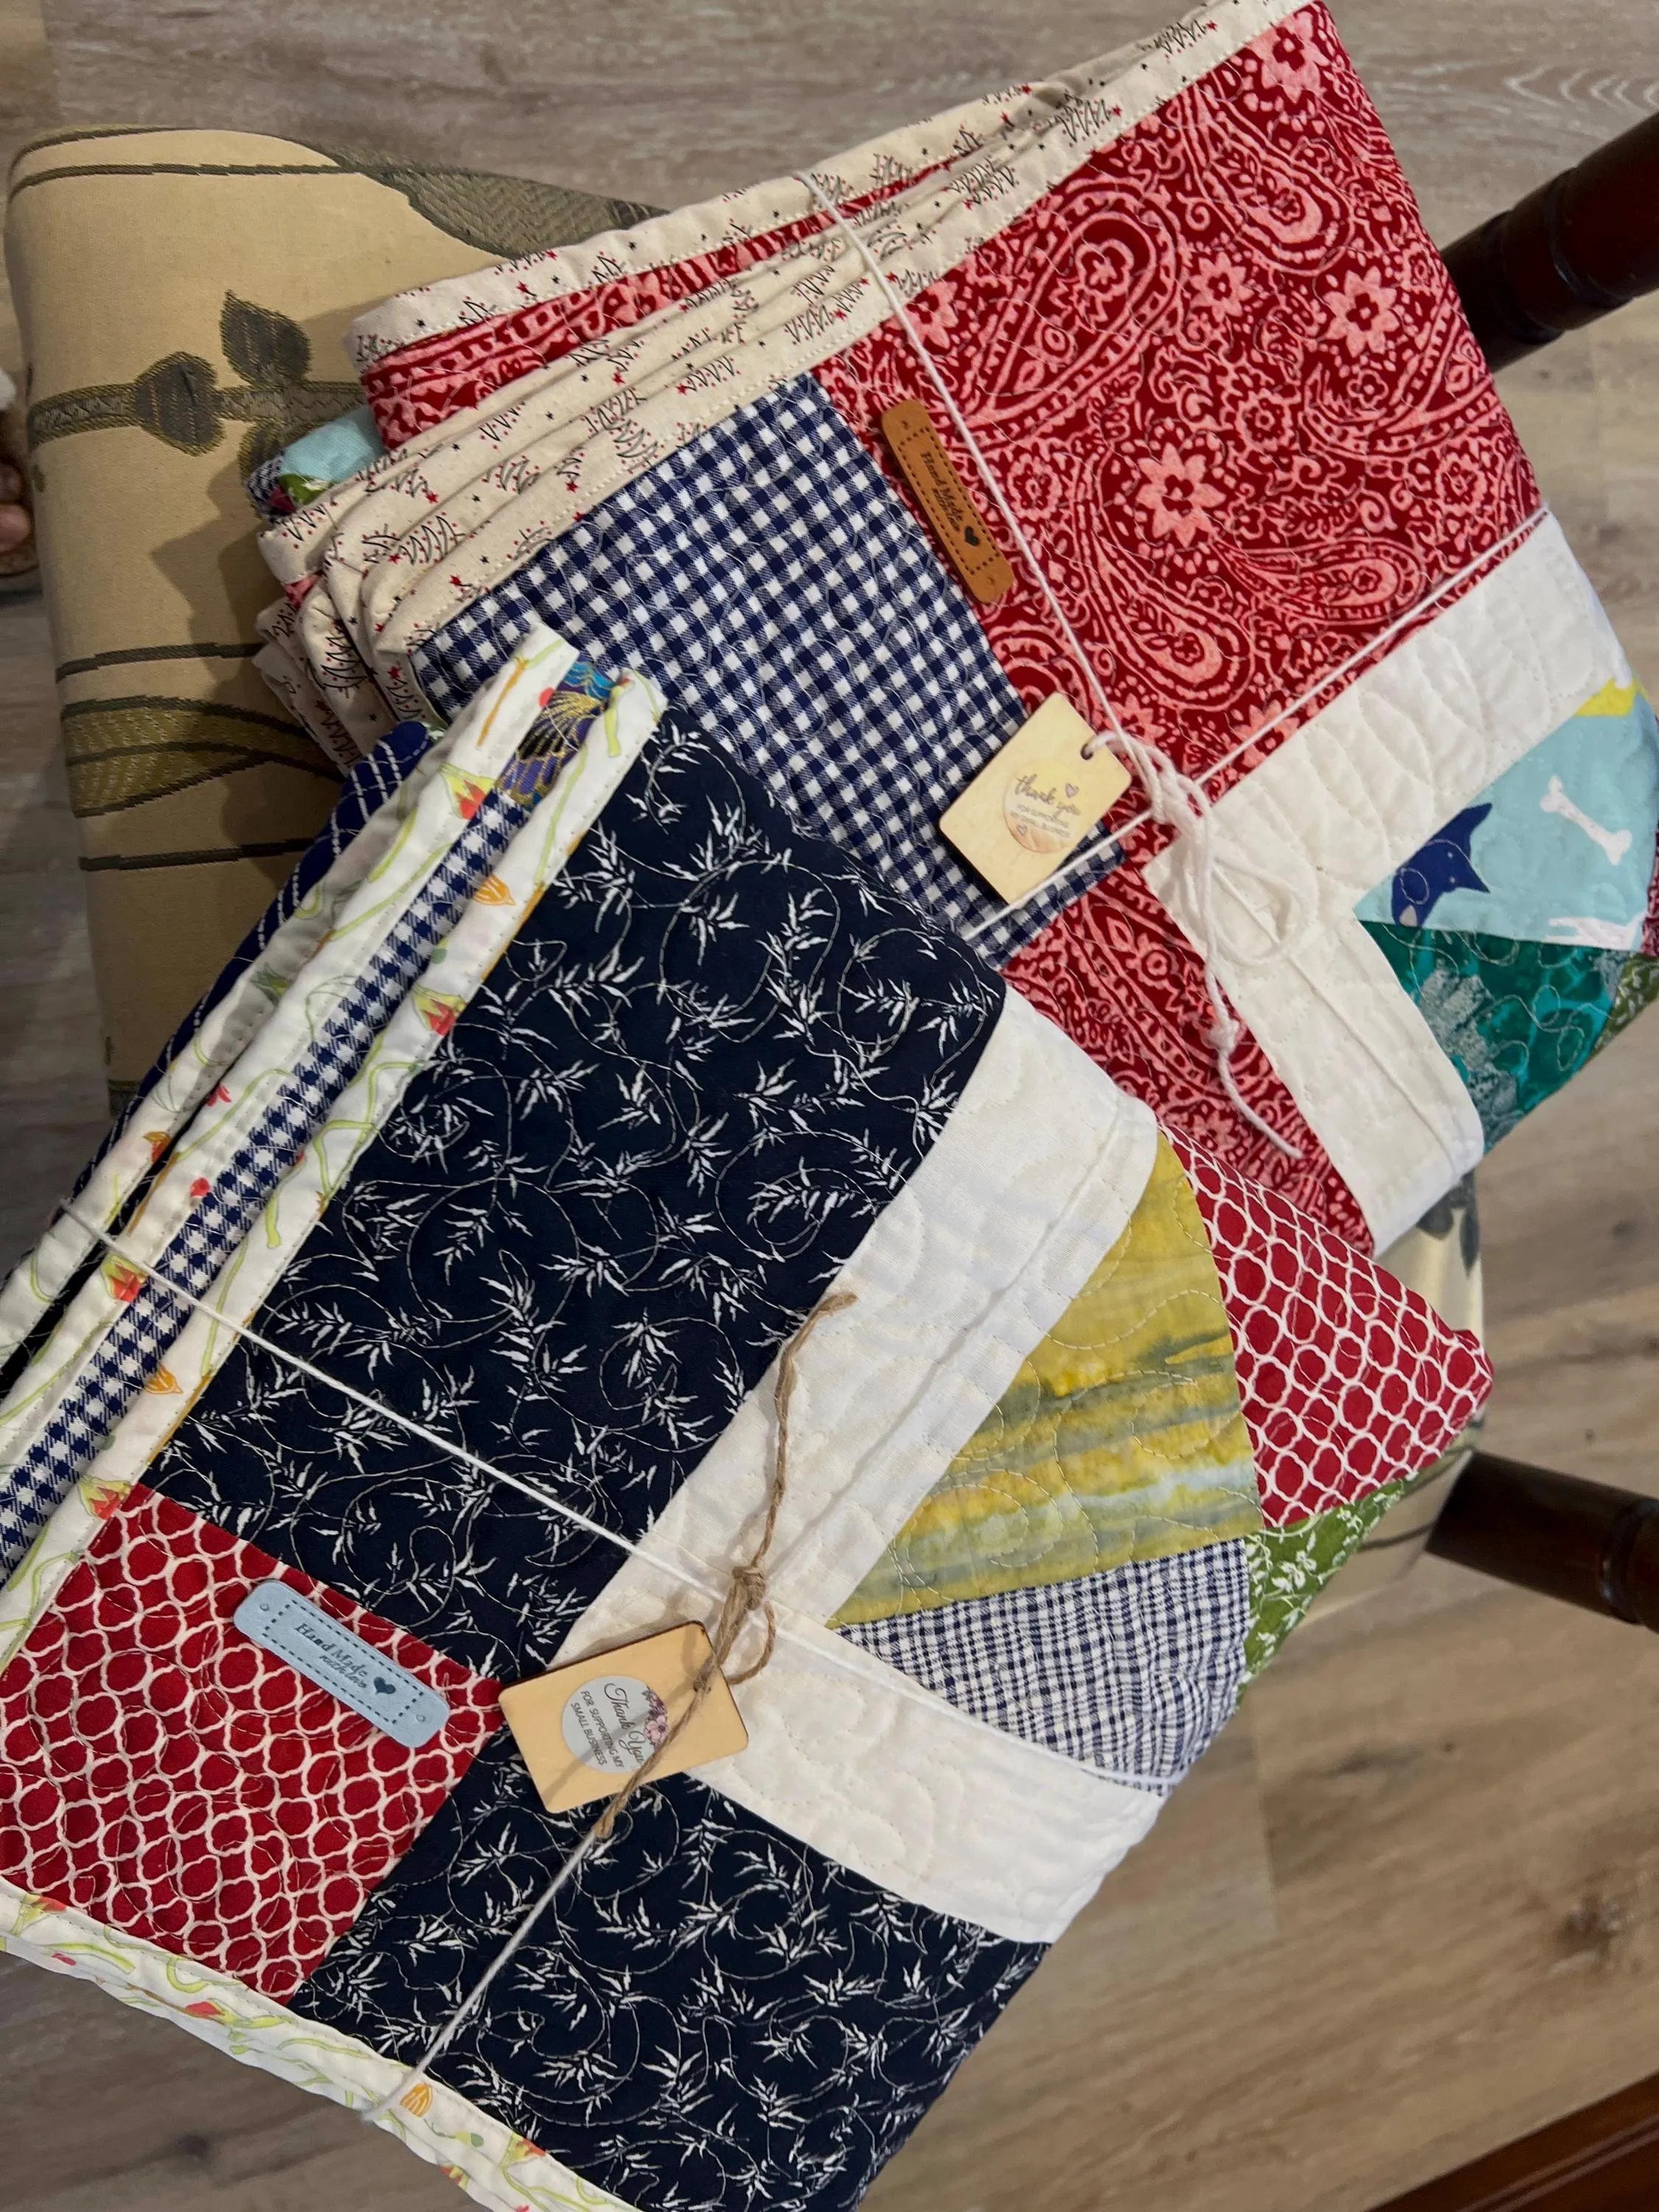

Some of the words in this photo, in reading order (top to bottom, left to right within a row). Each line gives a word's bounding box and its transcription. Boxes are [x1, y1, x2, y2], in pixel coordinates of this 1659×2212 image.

[920, 451, 947, 487] Hand
[939, 487, 964, 522] Made
[1015, 773, 1057, 806] thank
[1053, 803, 1081, 821] you
[295, 1623, 337, 1652] Hand
[330, 1649, 368, 1677] Made
[581, 1691, 595, 1706] FOR
[589, 1708, 619, 1756] SUPPORTING
[613, 1756, 625, 1768] MY
[604, 1683, 636, 1730] Thank
[571, 1702, 589, 1729] SMALL
[584, 1728, 608, 1766] BUSINESS
[619, 1731, 646, 1764] You
